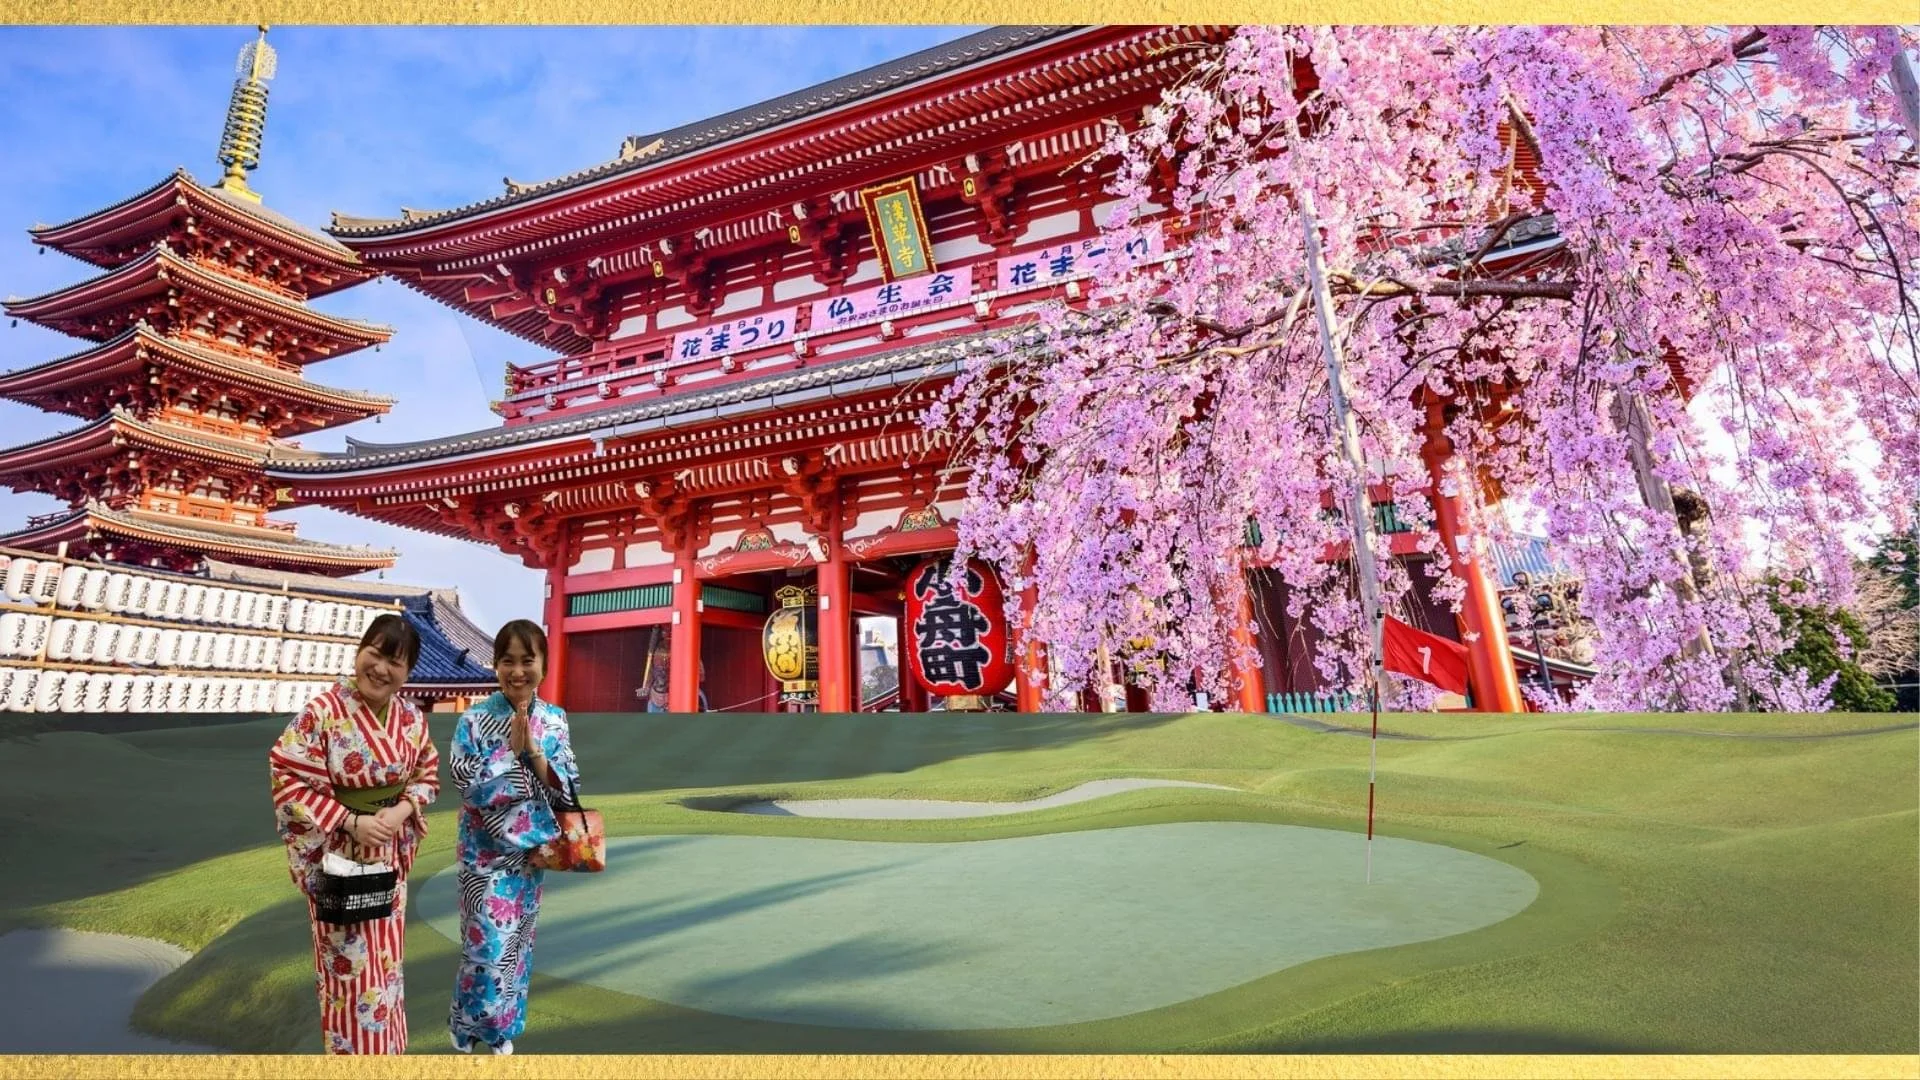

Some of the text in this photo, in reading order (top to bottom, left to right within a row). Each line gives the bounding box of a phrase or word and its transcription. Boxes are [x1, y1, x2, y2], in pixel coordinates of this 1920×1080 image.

[827, 273, 955, 319] 仏生会
[681, 319, 785, 358] 花まつり
[914, 561, 992, 691] 小舟町
